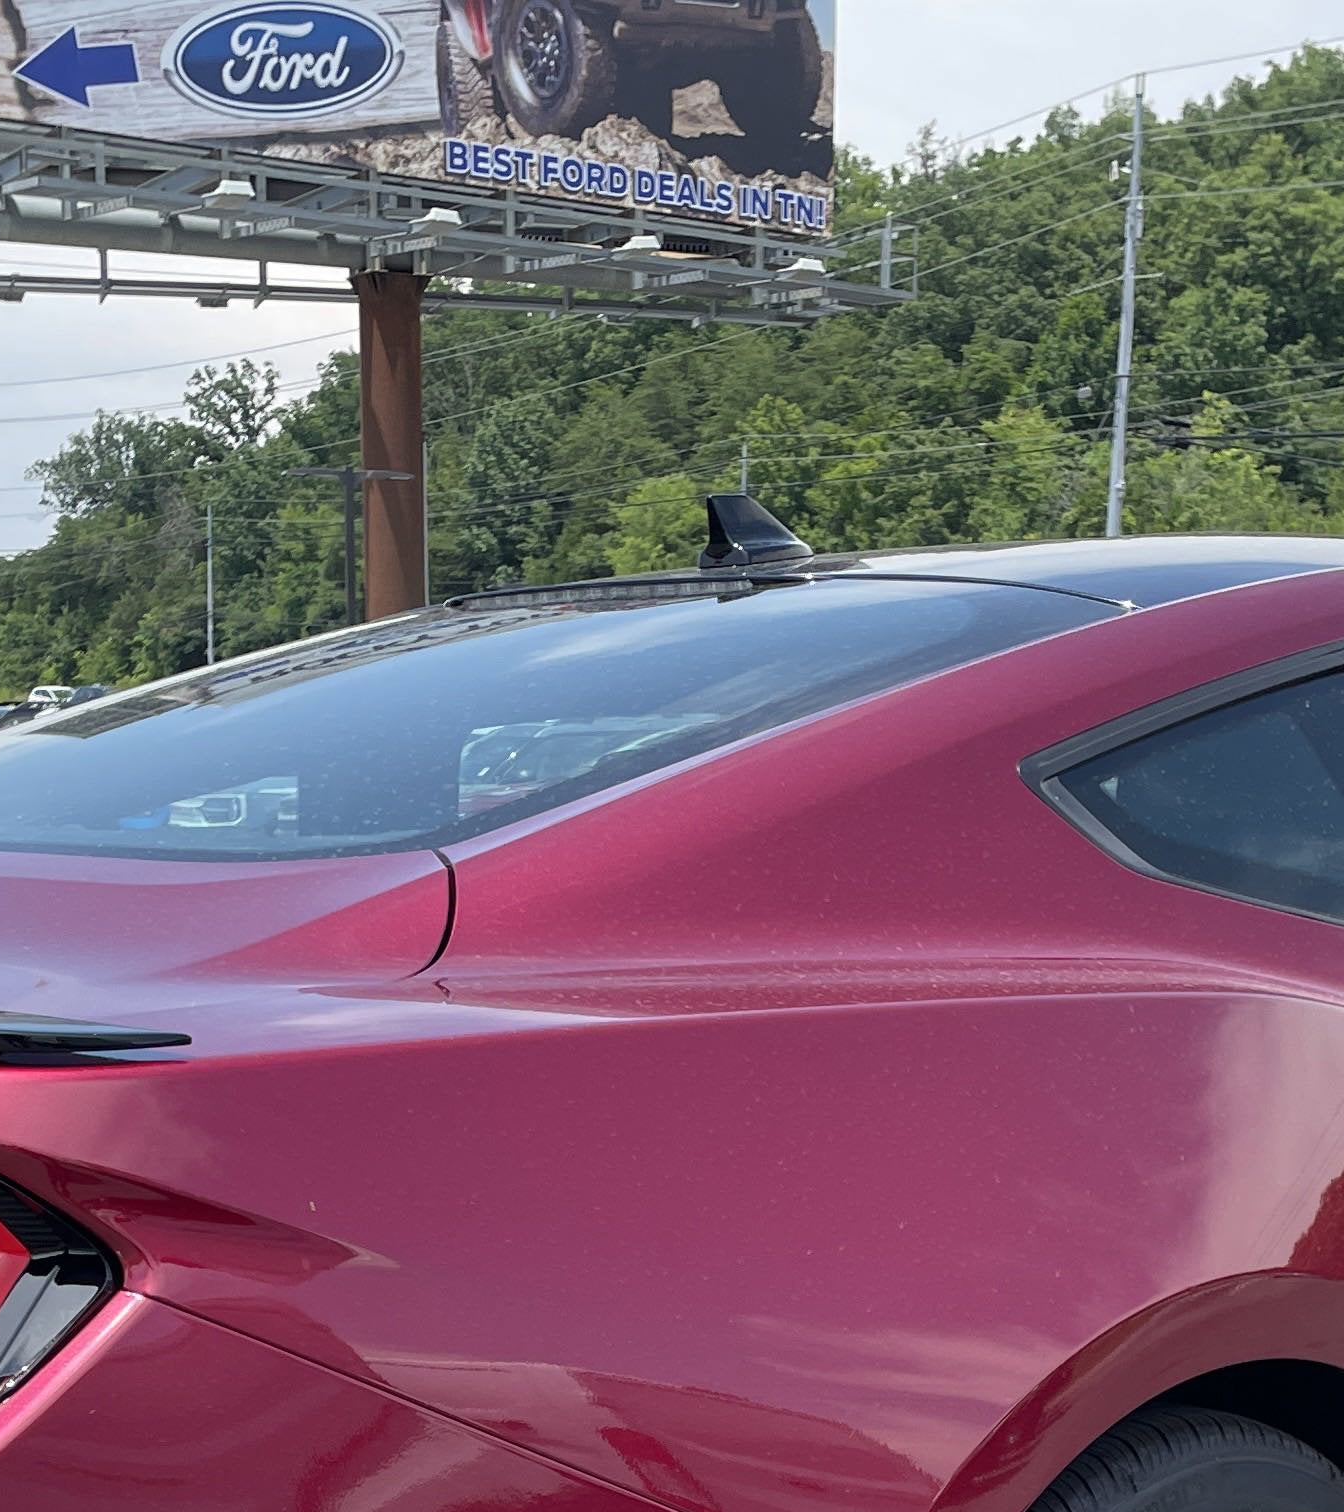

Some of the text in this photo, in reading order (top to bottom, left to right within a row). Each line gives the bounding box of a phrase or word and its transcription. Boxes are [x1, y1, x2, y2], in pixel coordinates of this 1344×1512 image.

[222, 21, 350, 95] Ford
[444, 140, 827, 230] BEST FORD DEALS IN TN!
